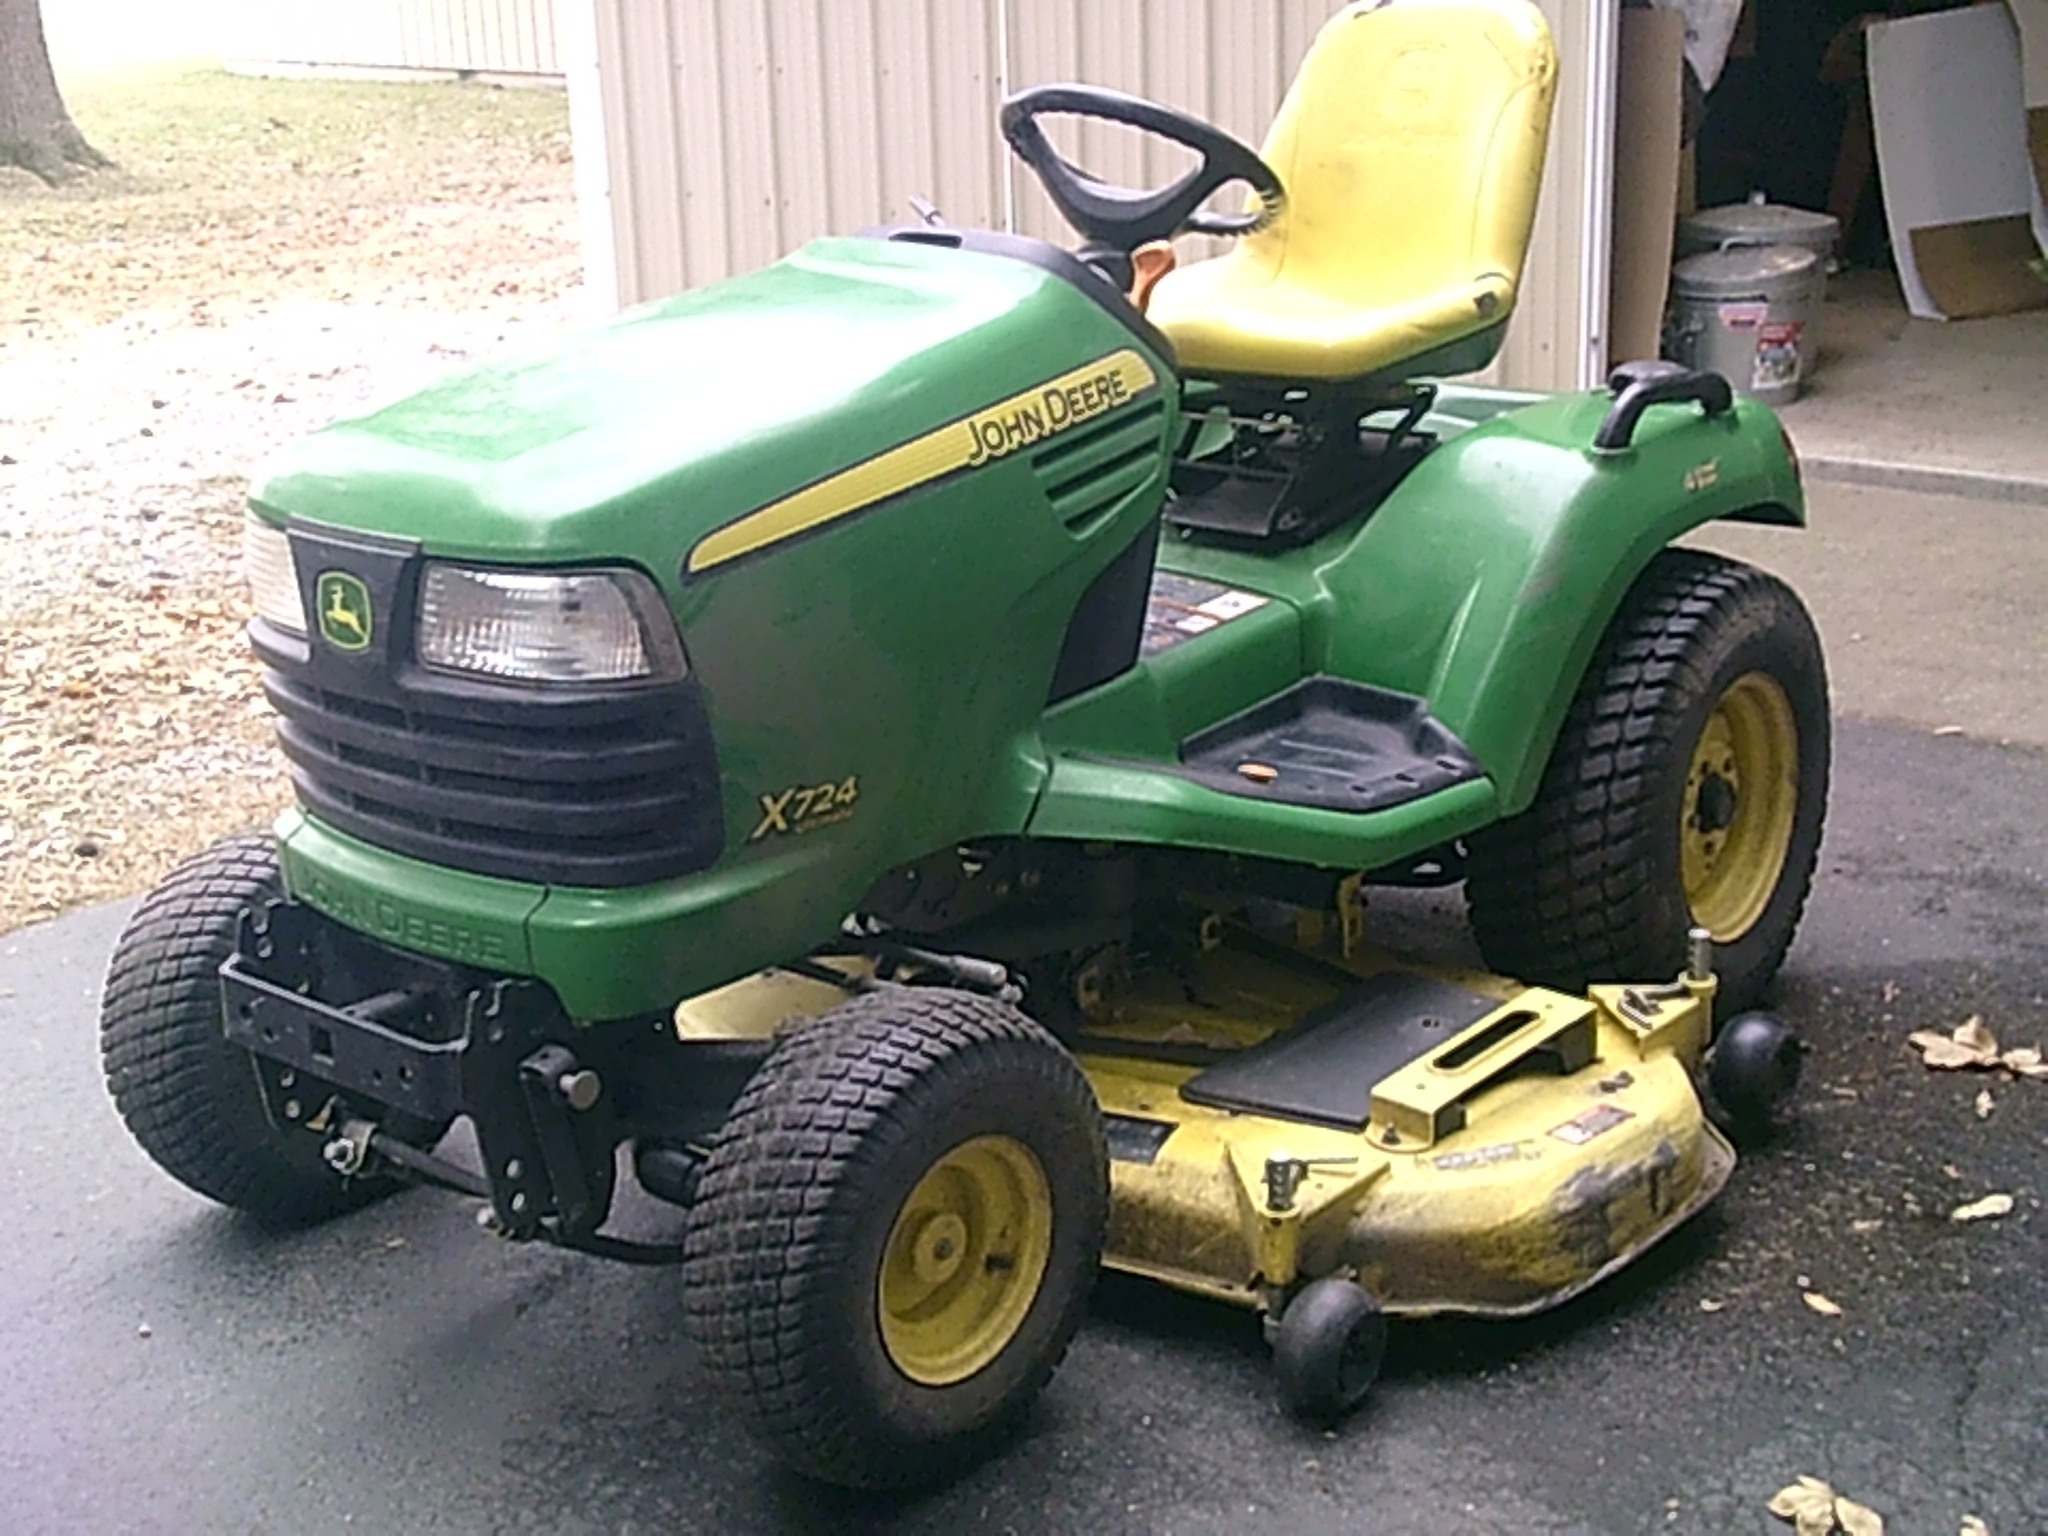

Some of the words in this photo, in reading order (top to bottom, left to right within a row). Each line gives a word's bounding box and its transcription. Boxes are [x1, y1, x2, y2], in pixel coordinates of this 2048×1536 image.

[968, 404, 1044, 462] JOHN
[1042, 370, 1127, 426] DEERE
[751, 775, 857, 839] X724
[376, 897, 507, 964] DEERE
